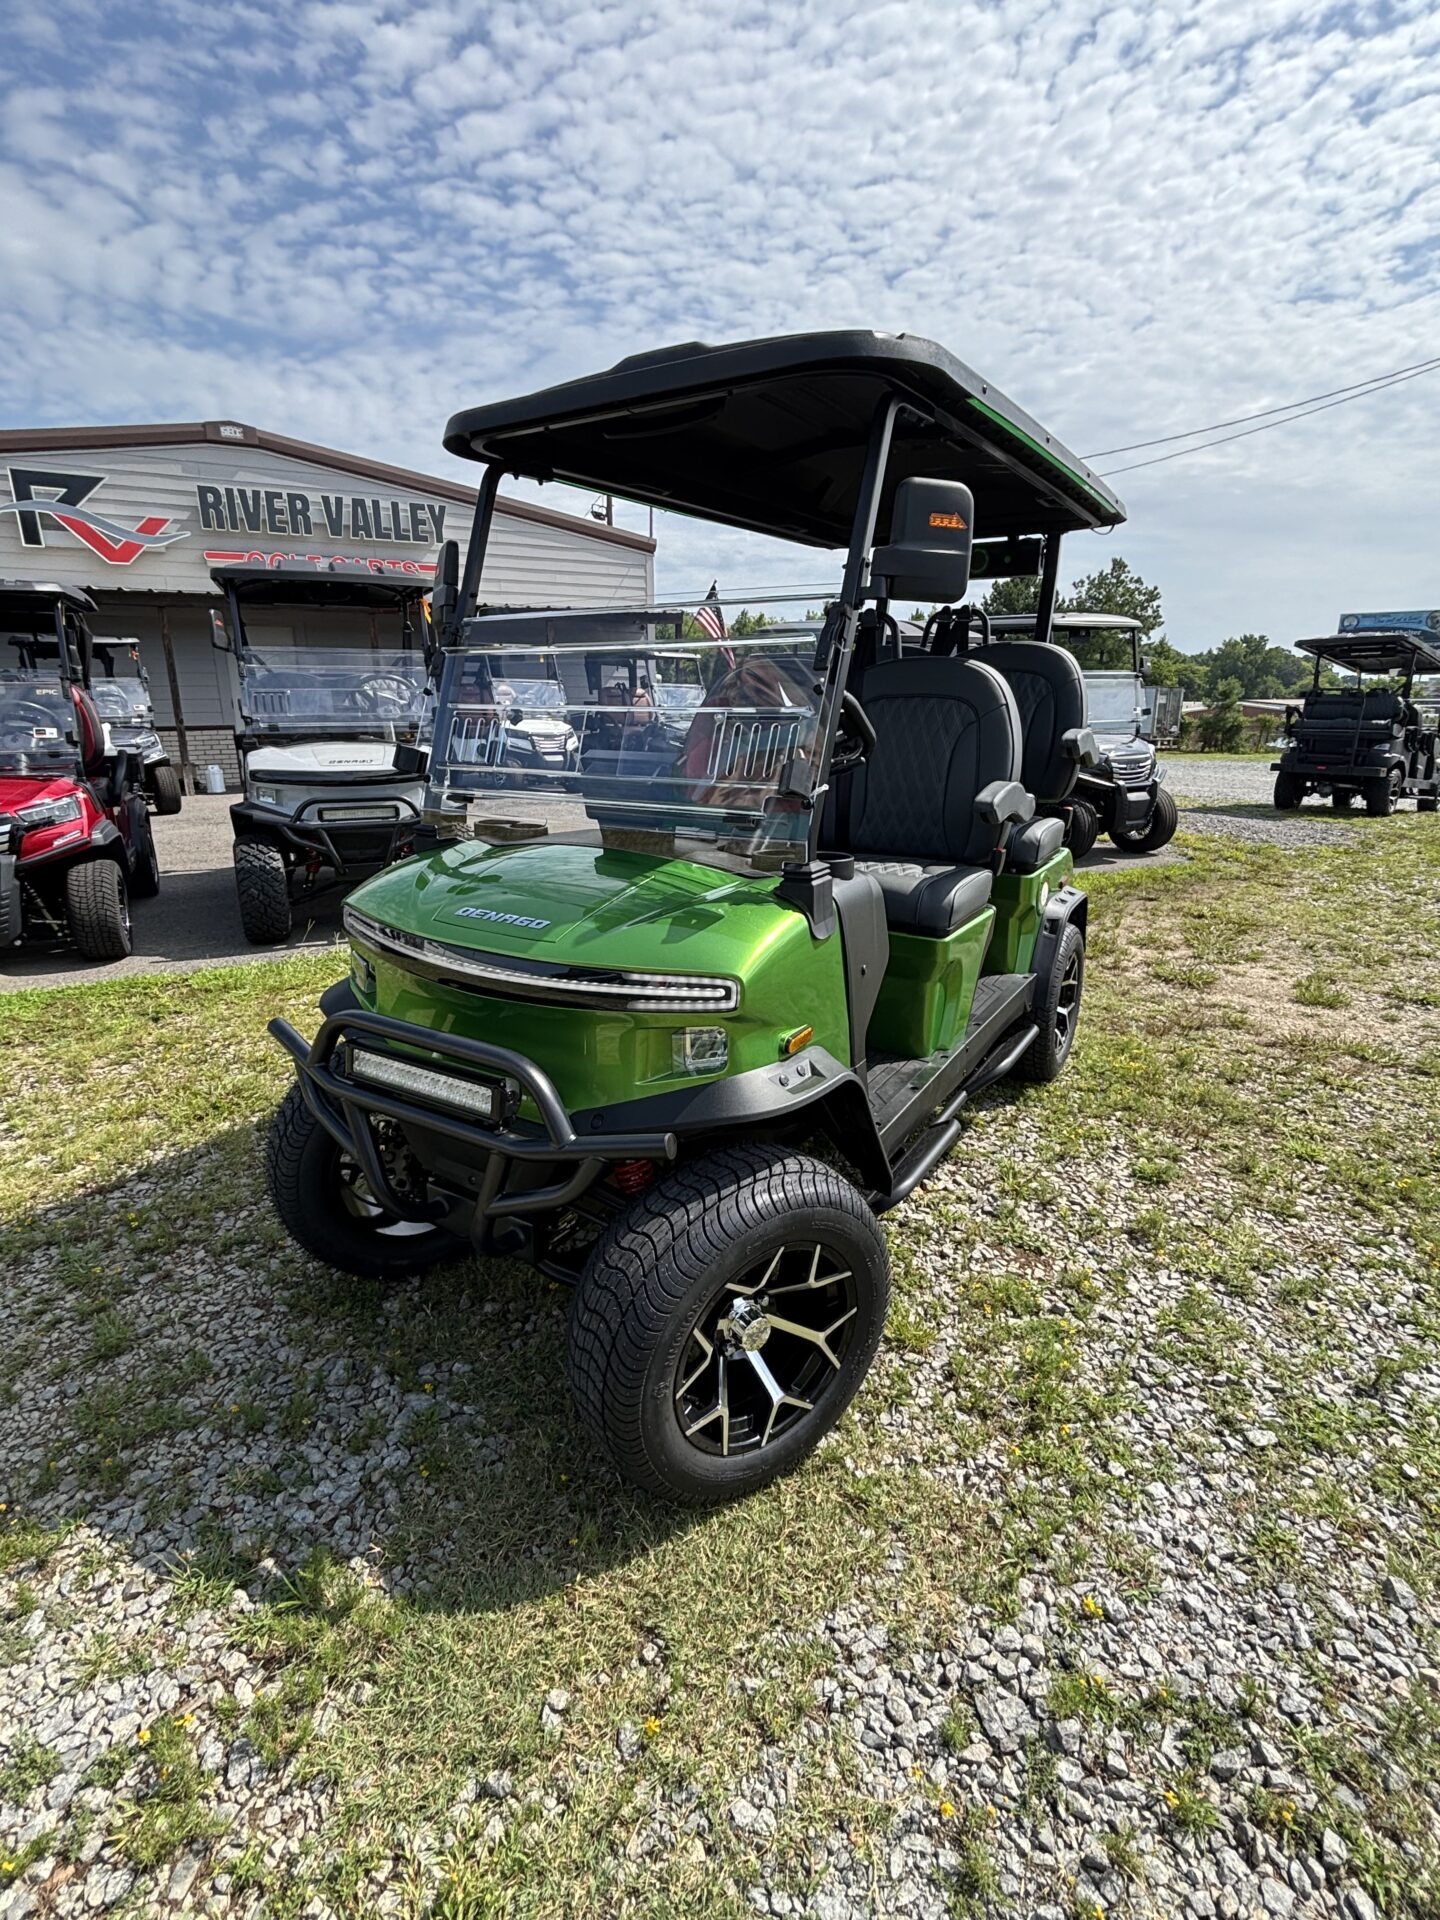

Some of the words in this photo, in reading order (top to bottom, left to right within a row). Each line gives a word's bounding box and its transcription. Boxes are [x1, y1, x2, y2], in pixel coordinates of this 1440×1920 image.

[196, 484, 313, 537] RIVER
[321, 494, 448, 545] VALLEY
[330, 556, 417, 575] RTS
[35, 688, 59, 696] EPIC
[453, 906, 552, 930] DENAGO
